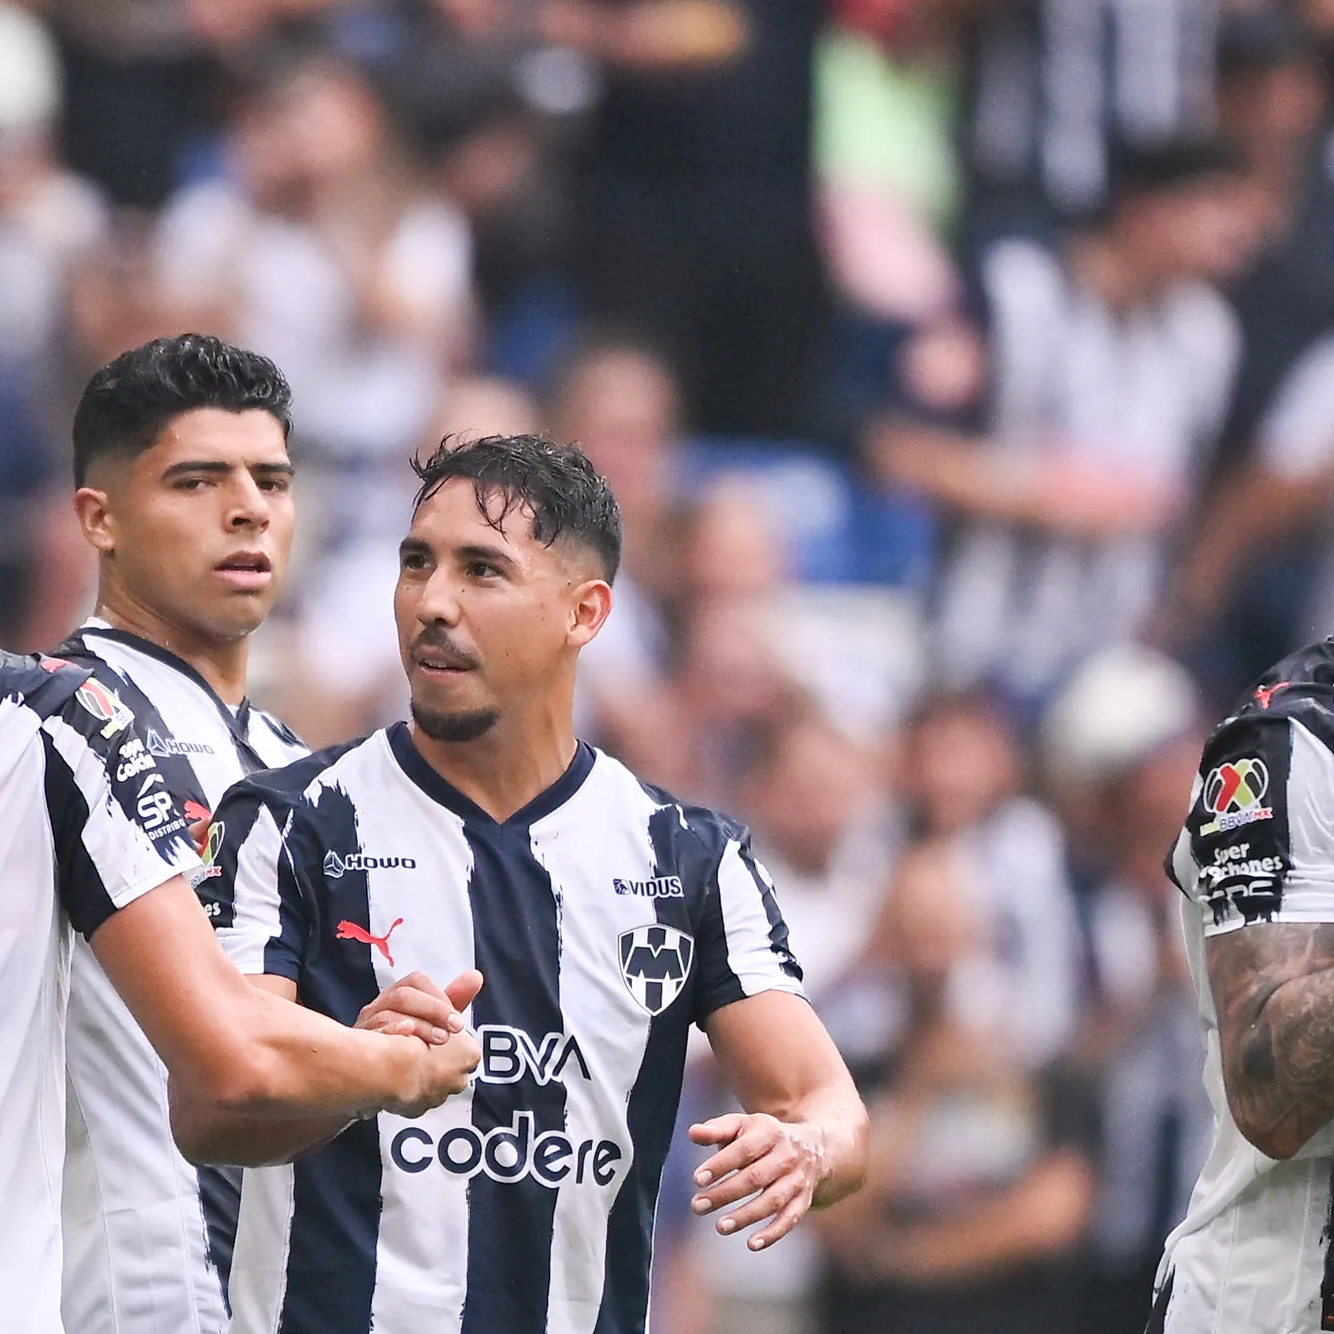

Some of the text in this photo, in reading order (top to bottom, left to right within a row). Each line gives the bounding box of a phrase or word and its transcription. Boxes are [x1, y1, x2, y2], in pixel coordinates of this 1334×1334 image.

[629, 878, 682, 898] VIDUS
[481, 1029, 592, 1082] BVA
[391, 1115, 622, 1187] codere
